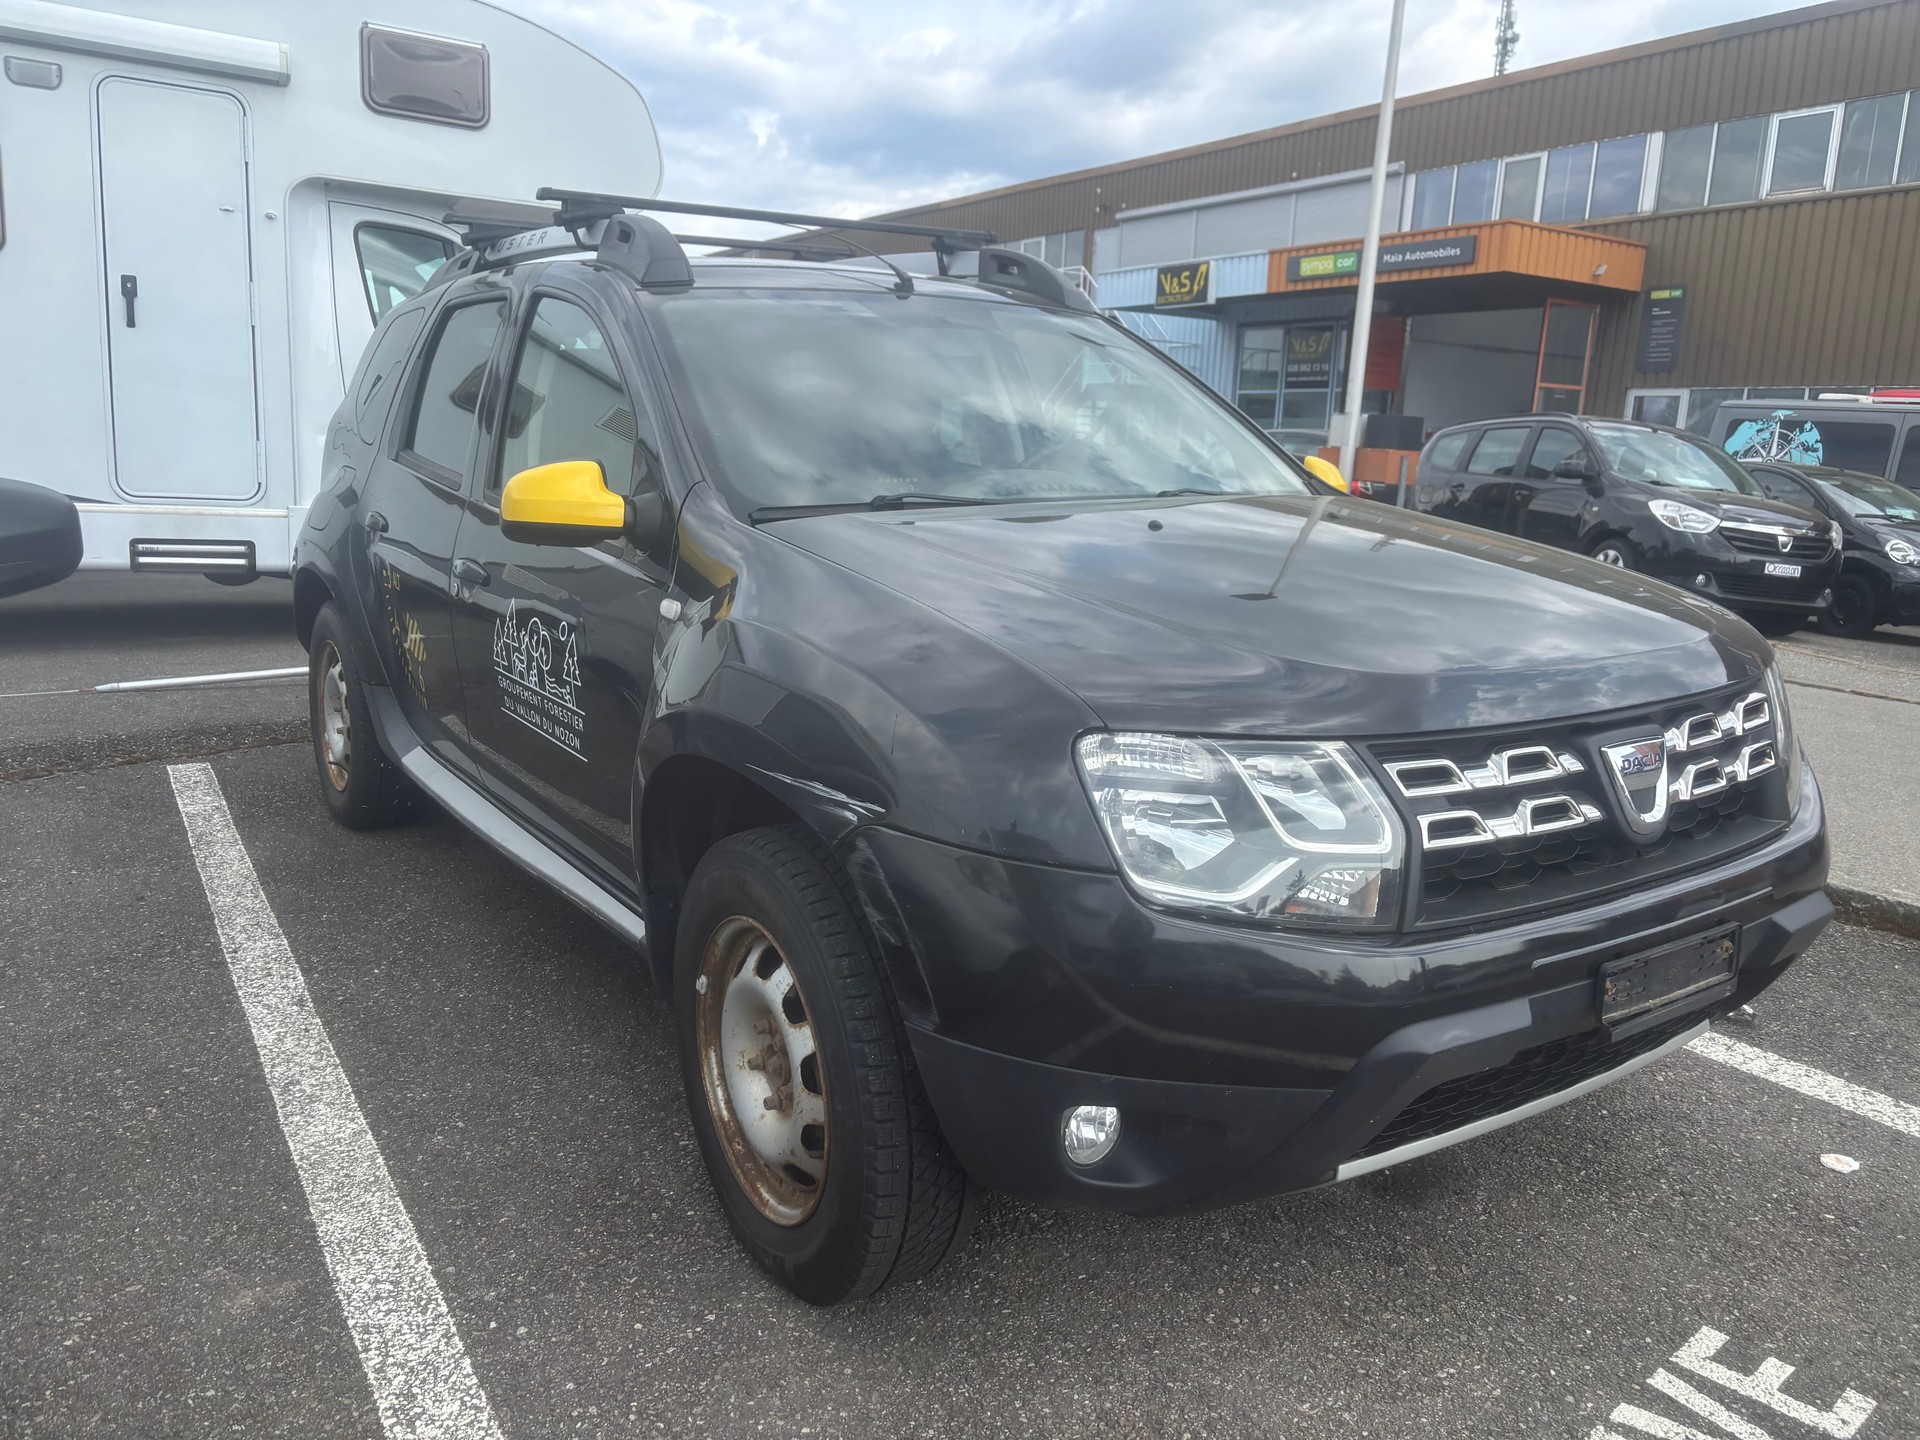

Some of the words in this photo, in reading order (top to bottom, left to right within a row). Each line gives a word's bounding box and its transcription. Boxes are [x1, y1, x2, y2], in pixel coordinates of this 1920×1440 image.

[493, 230, 548, 253] USTER
[1336, 257, 1355, 268] car
[1404, 246, 1461, 262] Automobiles
[1160, 271, 1191, 294] V&S
[1292, 336, 1317, 352] V&S
[498, 676, 541, 708] GROUPEMENT
[544, 700, 583, 731] FORESTIER
[504, 696, 514, 710] DU
[515, 702, 541, 726] VALLON
[542, 717, 553, 732] DU
[555, 725, 581, 750] NOZON
[1621, 753, 1663, 773] DACIA
